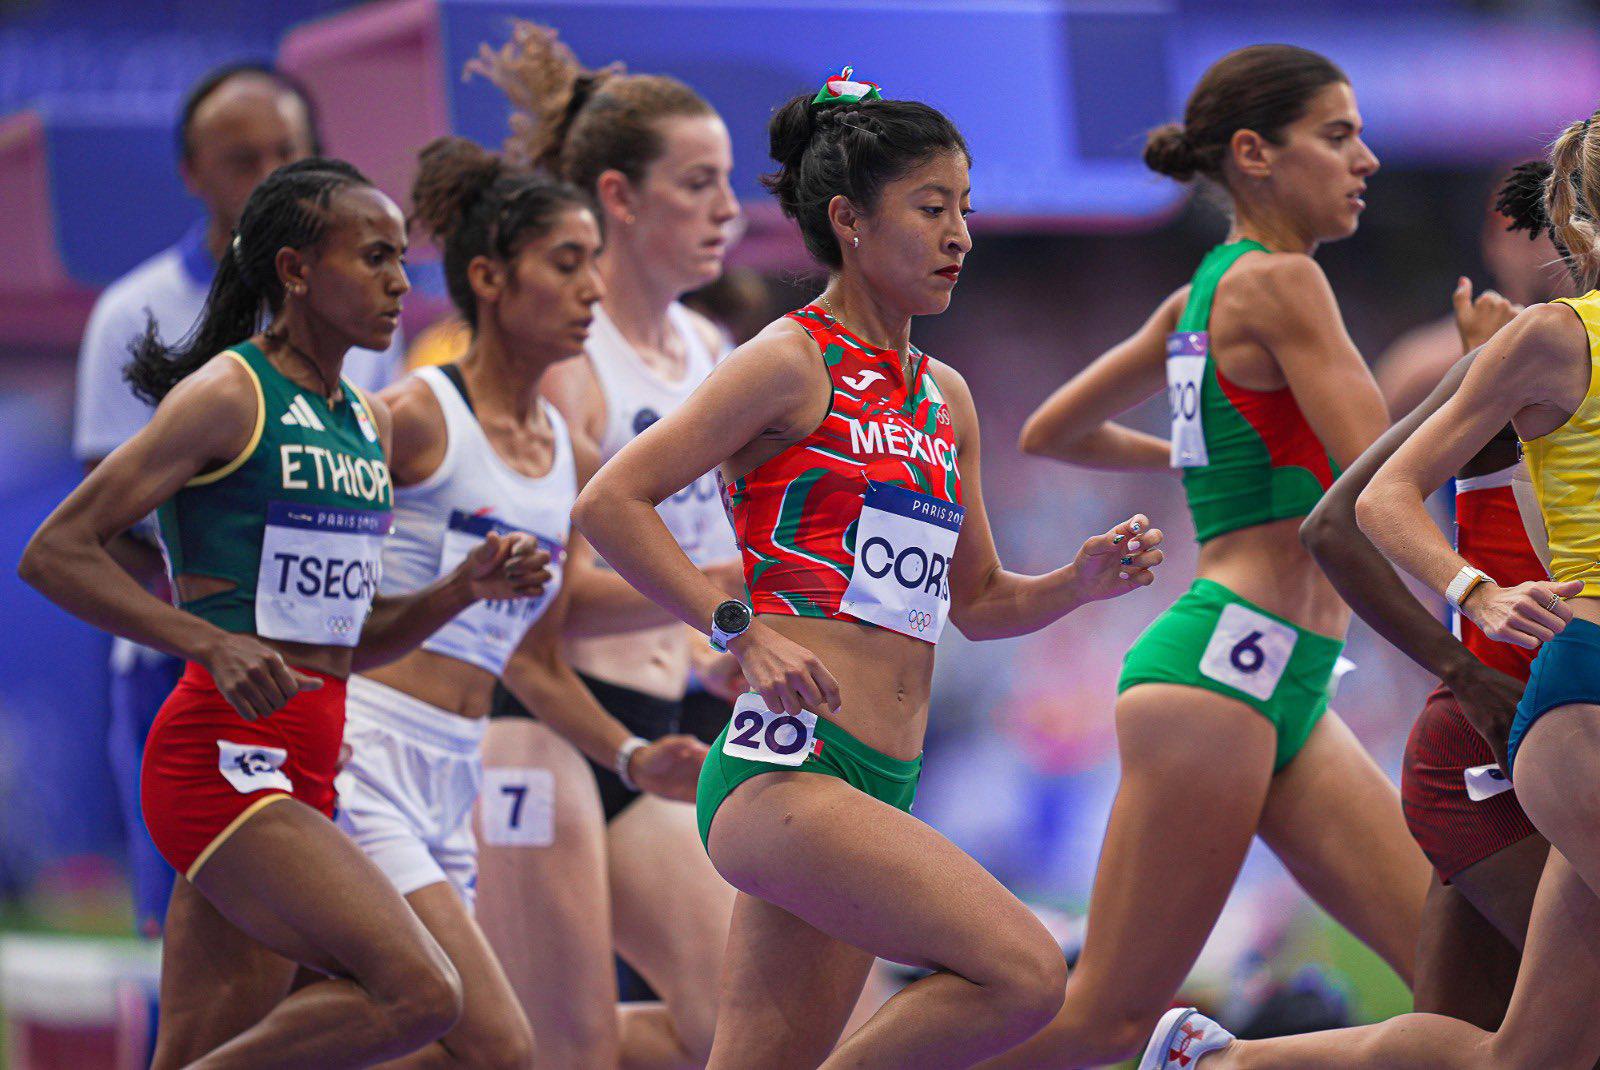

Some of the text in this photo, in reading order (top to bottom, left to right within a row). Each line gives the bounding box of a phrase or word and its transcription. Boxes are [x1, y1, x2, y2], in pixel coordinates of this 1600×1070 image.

[912, 499, 947, 519] PARIS
[1230, 630, 1265, 675] 6
[728, 710, 808, 755] 20
[500, 784, 529, 832] 7
